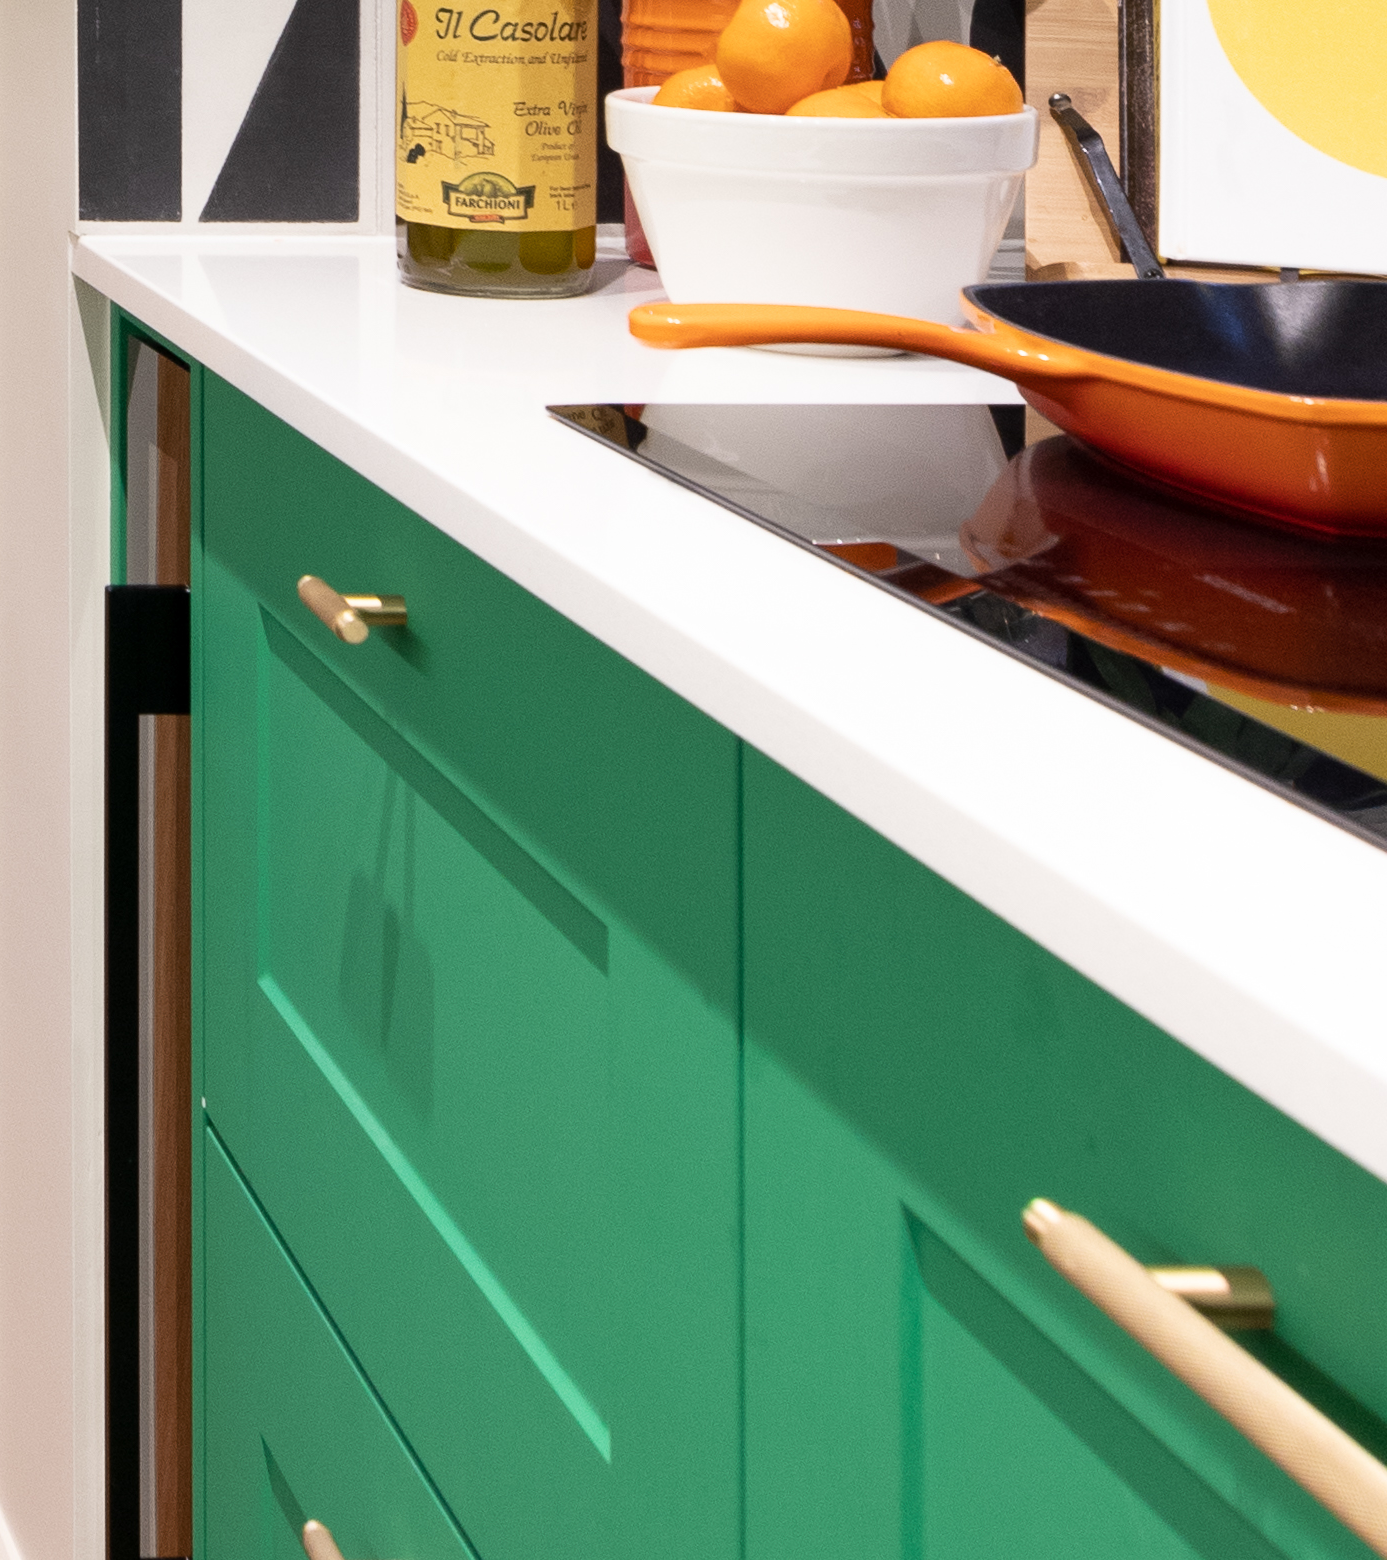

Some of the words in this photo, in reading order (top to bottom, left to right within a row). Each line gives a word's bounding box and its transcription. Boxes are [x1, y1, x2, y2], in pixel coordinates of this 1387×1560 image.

[435, 7, 463, 40] Il
[469, 9, 588, 42] Casolare
[461, 51, 525, 66] Extraction
[527, 51, 547, 64] and
[513, 101, 551, 117] Extra
[525, 120, 561, 137] Olive
[455, 196, 521, 211] FARCHIONI
